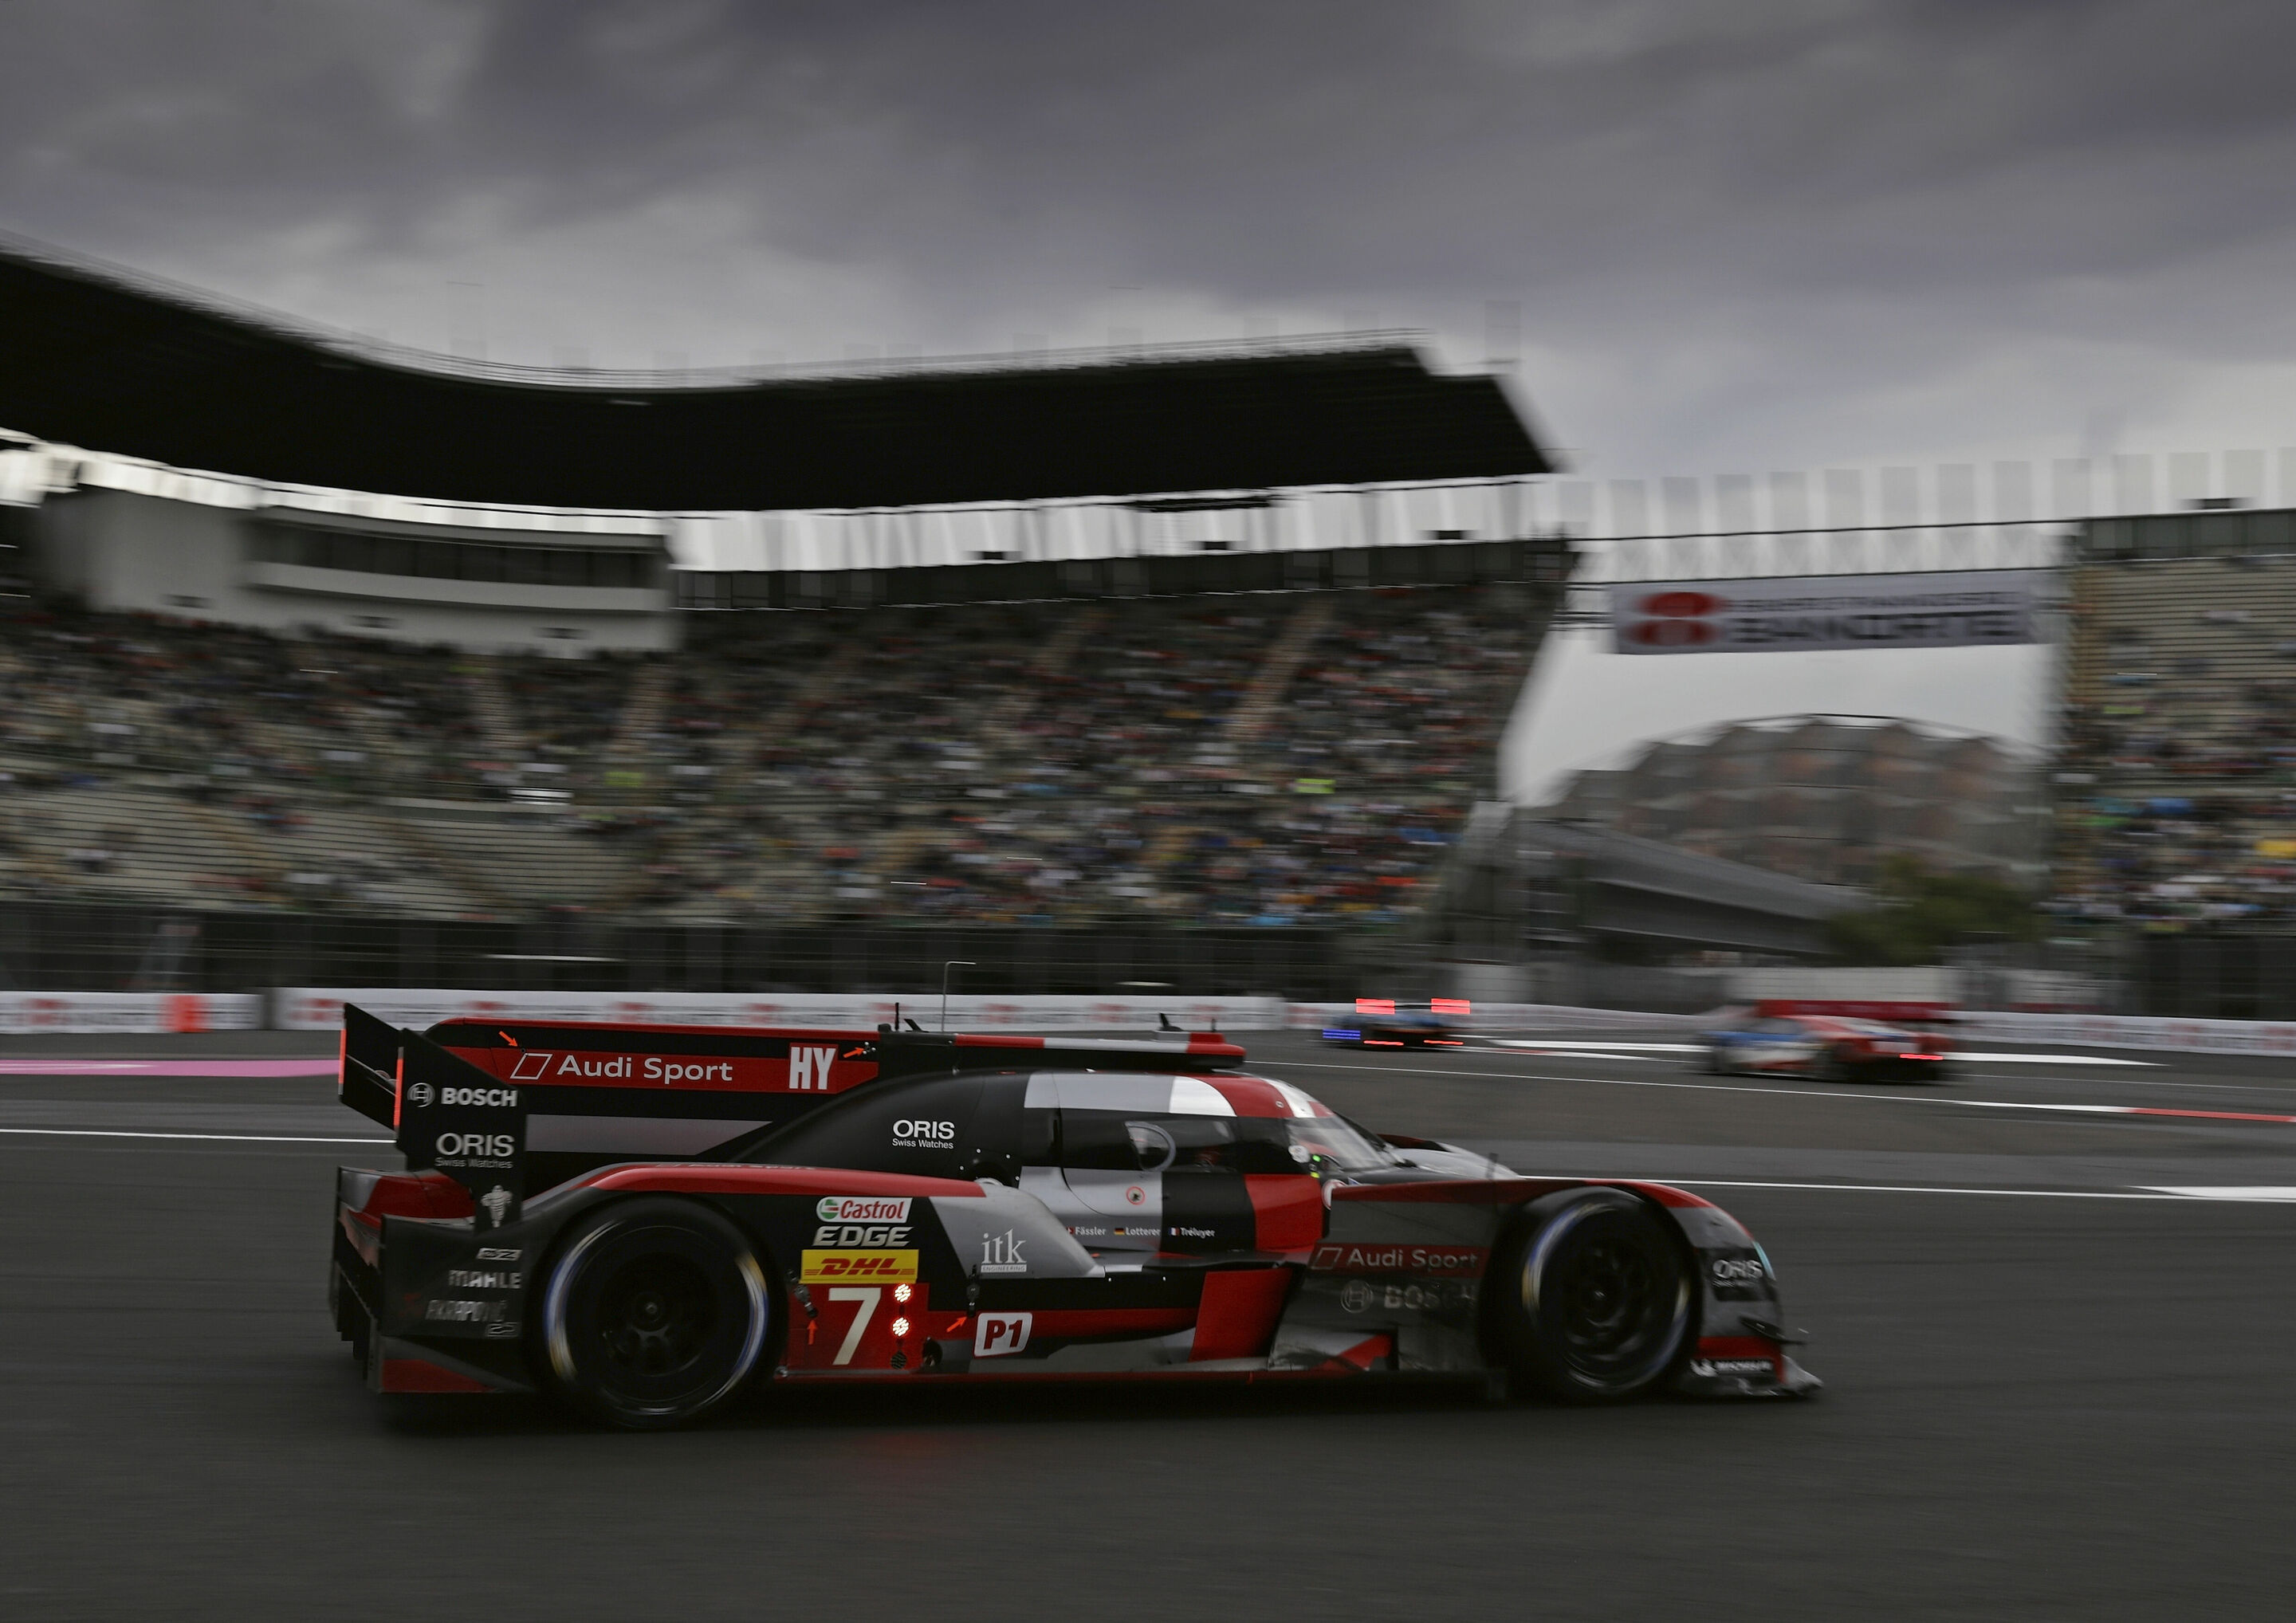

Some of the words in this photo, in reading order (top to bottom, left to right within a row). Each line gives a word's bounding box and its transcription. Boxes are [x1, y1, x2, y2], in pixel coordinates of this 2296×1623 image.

[556, 1054, 631, 1079] Audi
[643, 1058, 733, 1085] Sport
[788, 1047, 836, 1091] HY
[441, 1087, 518, 1107] BOSCH
[893, 1119, 955, 1140] ORIS
[435, 1132, 516, 1157] ORIS
[892, 1138, 917, 1148] Swiss
[918, 1139, 954, 1149] Watches
[434, 1157, 467, 1168] Swiss
[467, 1157, 514, 1169] Watches
[840, 1200, 904, 1220] Castrol
[812, 1225, 914, 1247] EDGE
[1075, 1226, 1107, 1236] Fässler
[1126, 1226, 1162, 1236] Lotterer
[981, 1228, 1028, 1264] itk
[820, 1258, 901, 1275] DHL
[1347, 1248, 1403, 1267] Audi
[1410, 1248, 1479, 1272] Sport
[448, 1269, 522, 1289] MAHLE
[828, 1287, 882, 1366] 7
[984, 1319, 1023, 1350] P1
